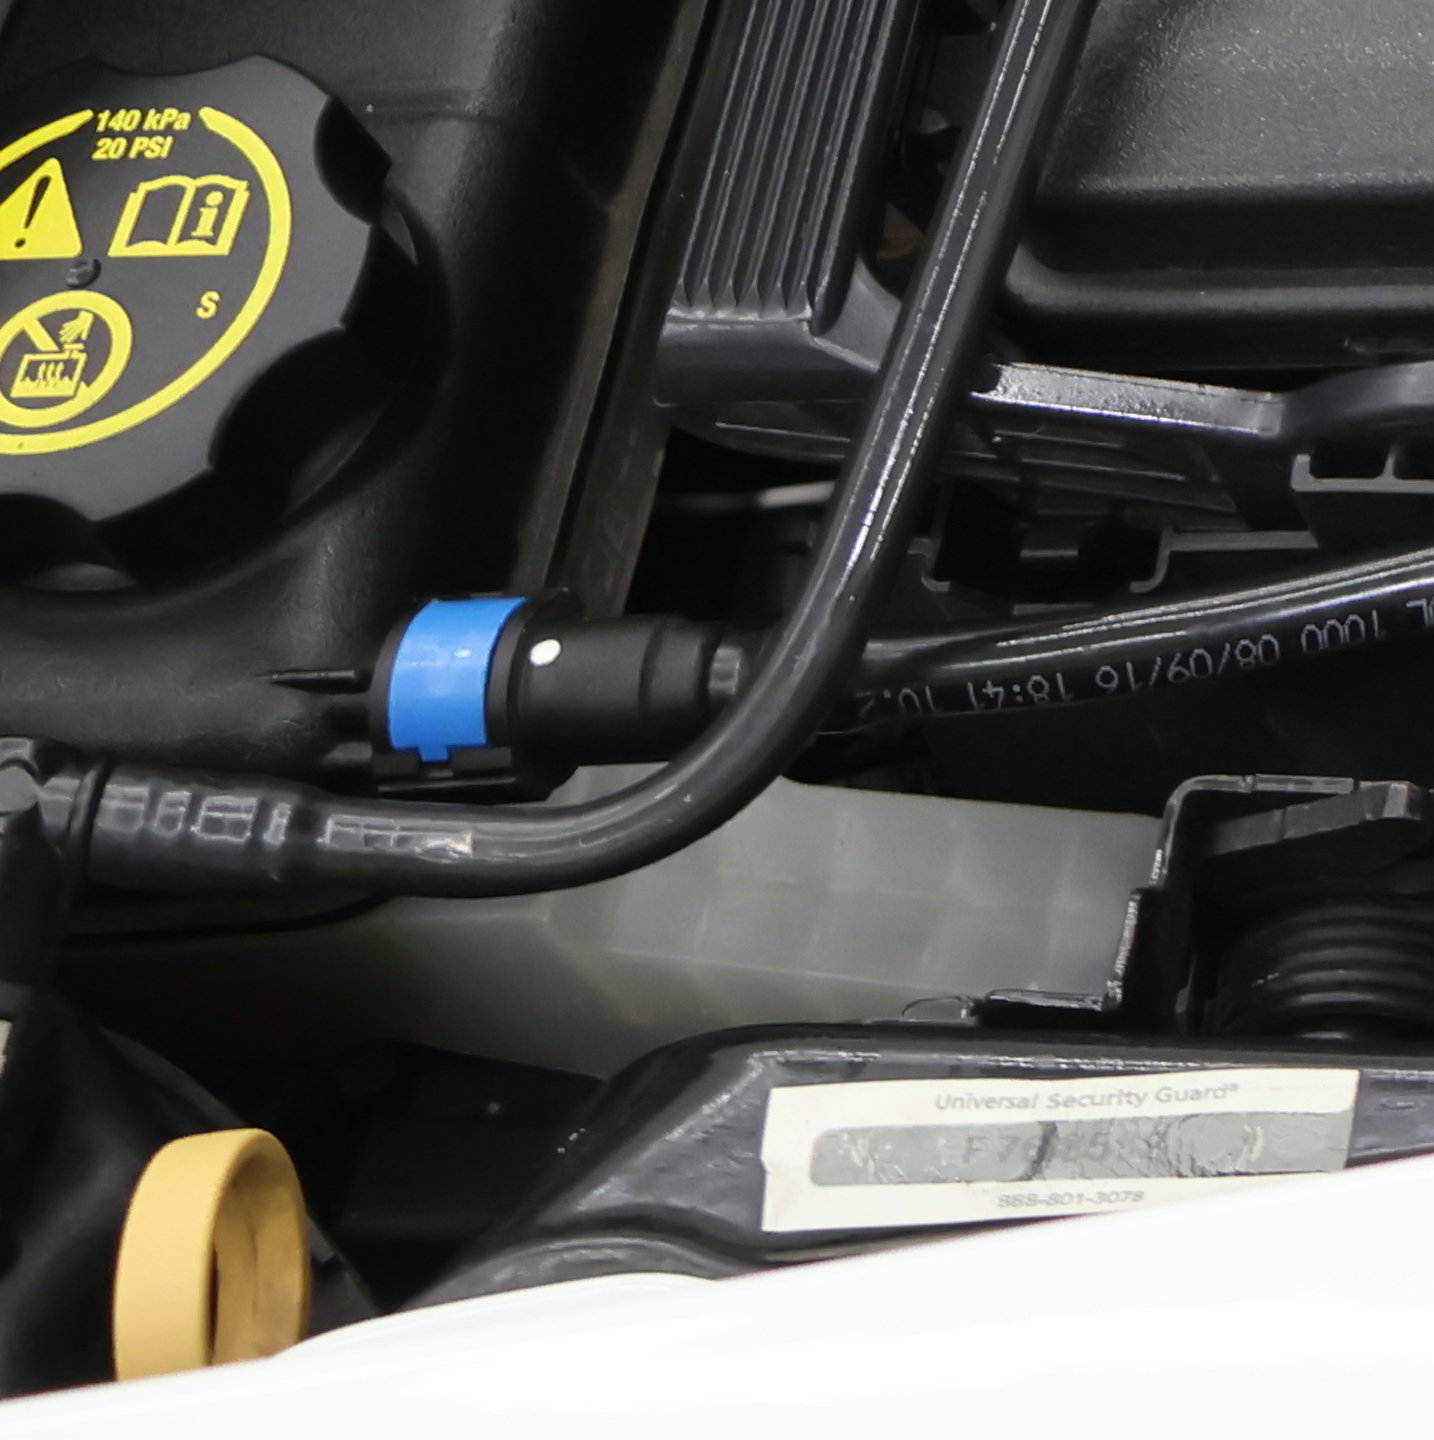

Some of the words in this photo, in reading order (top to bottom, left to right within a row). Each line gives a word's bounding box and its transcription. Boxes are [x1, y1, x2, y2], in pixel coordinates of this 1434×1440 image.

[97, 109, 141, 133] 140
[143, 108, 191, 131] kPa
[92, 137, 127, 160] 20
[129, 135, 174, 159] PSI
[196, 290, 222, 319] S
[1299, 608, 1386, 655] 1000
[1094, 632, 1281, 695] 08/09/16
[964, 670, 1073, 712] 18:41
[934, 1092, 1039, 1110] Universal
[1047, 1088, 1148, 1110] Security
